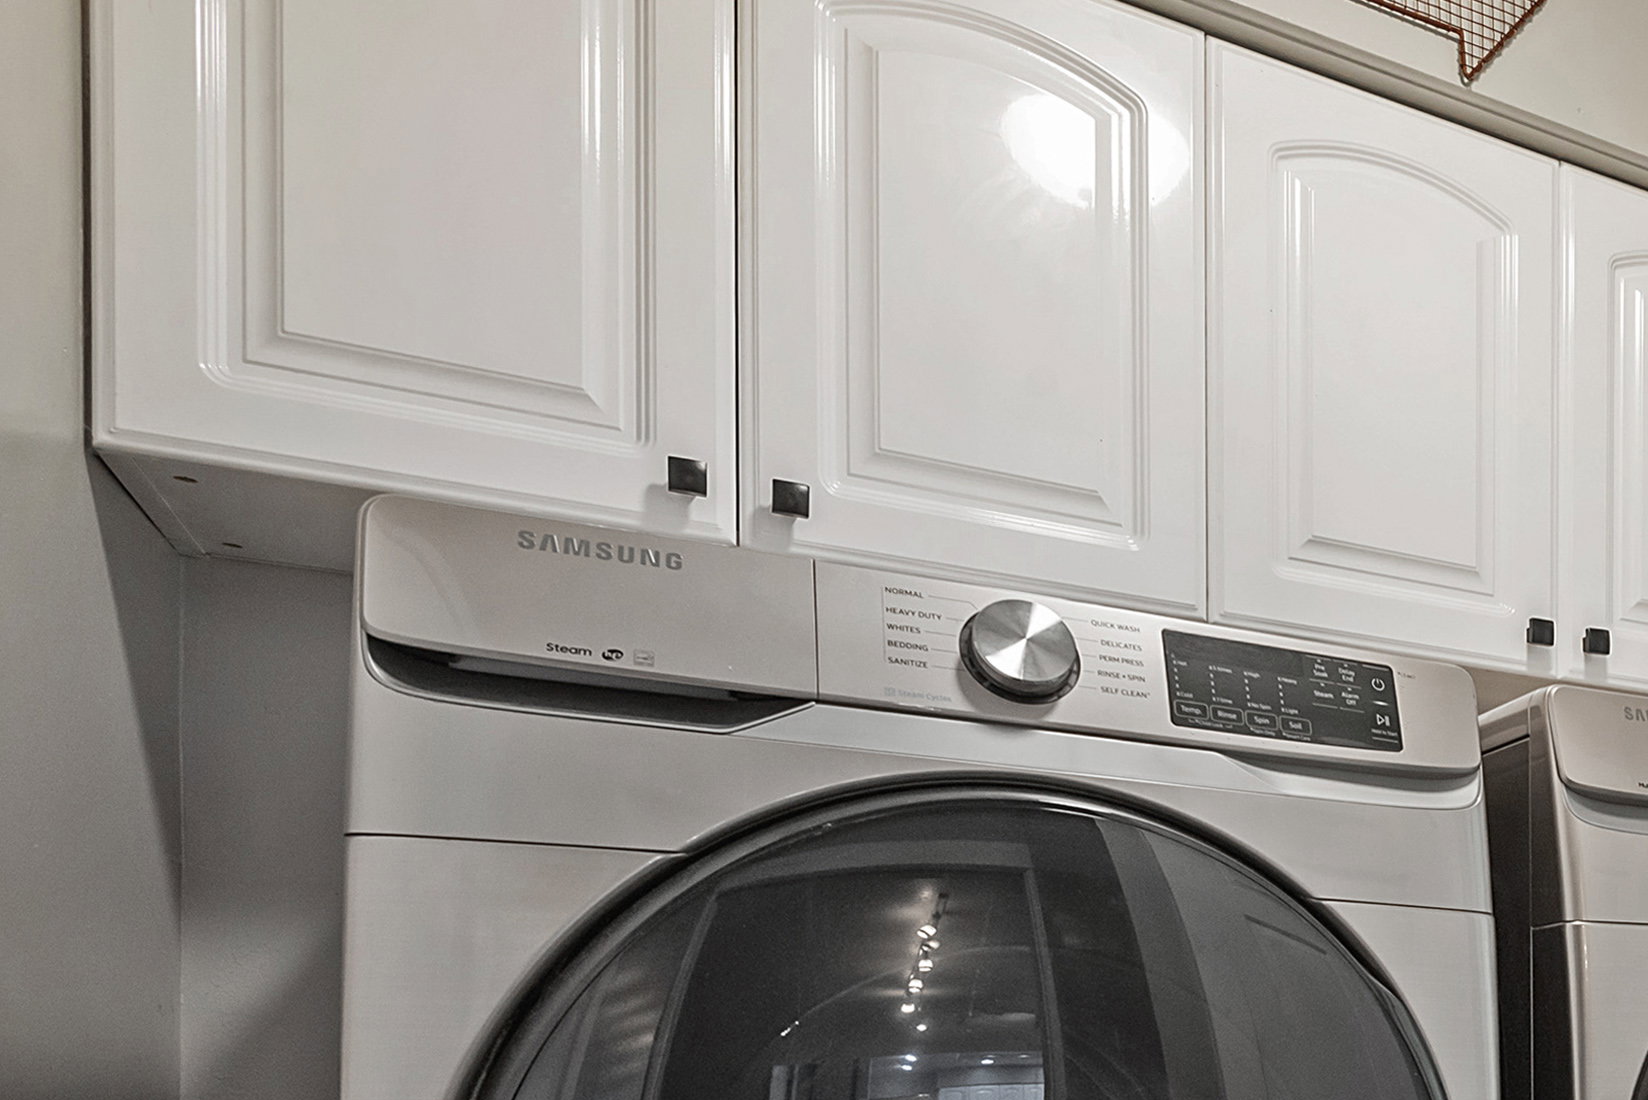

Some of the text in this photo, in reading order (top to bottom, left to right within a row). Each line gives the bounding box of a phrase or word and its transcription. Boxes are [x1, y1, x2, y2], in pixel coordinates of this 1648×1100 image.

[516, 530, 684, 571] SAMSUNG
[885, 587, 924, 599] NORMAL
[886, 607, 942, 620] HEAVY DUTY
[887, 623, 921, 634] WHITES
[1091, 620, 1140, 632] QUICK WASH
[546, 642, 592, 657] Steam
[887, 640, 929, 652] BEDDING
[1100, 640, 1142, 652] DELICATES
[888, 656, 928, 669] SANITIZE
[1099, 654, 1144, 667] PERM PRESS
[1097, 669, 1146, 682] RINSE SPIN
[1101, 686, 1118, 695] SELF
[1217, 710, 1237, 720] Rinse
[1253, 716, 1270, 724] Spin
[1288, 721, 1303, 730] Soil
